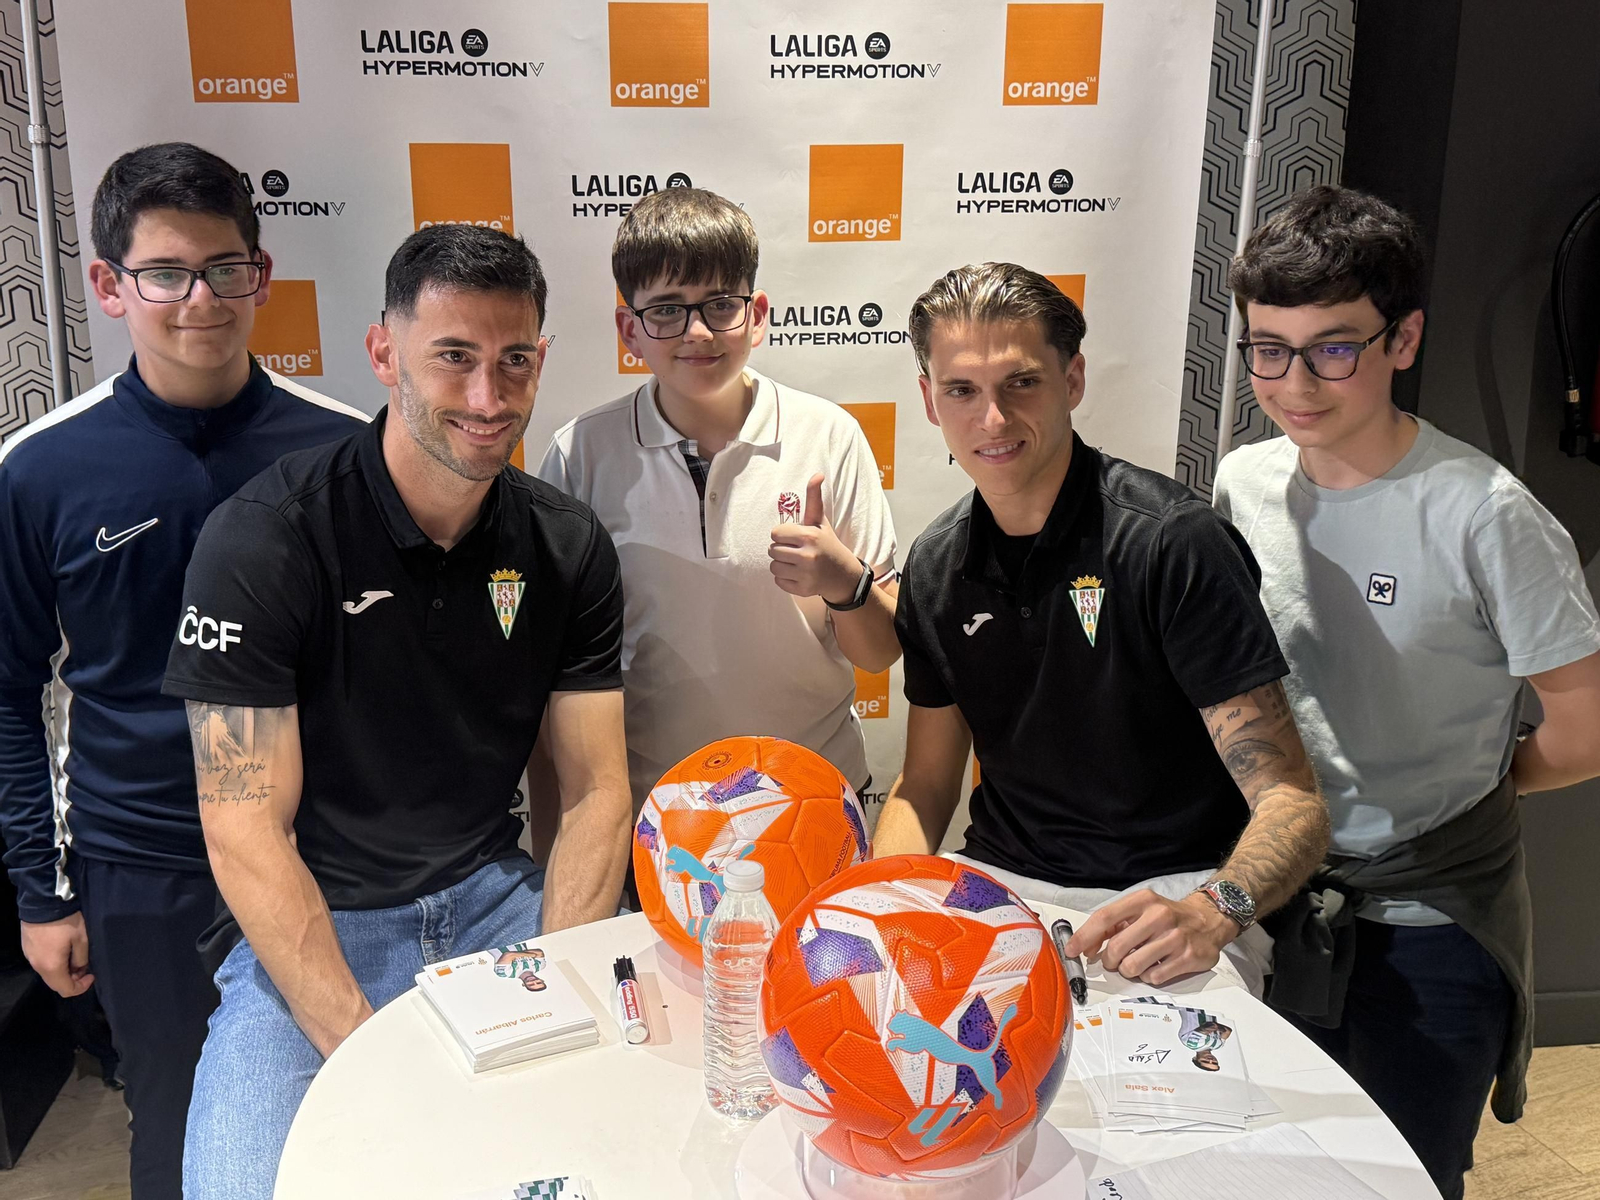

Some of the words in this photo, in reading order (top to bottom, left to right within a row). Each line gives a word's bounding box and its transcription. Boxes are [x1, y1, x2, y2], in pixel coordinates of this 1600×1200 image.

[360, 30, 454, 54] LALIGA
[770, 35, 858, 57] LALIGA
[198, 78, 288, 100] orange
[615, 83, 699, 104] orange
[1008, 82, 1089, 103] orange
[571, 175, 659, 197] LALIGA
[957, 172, 1042, 194] LALIGA
[813, 218, 892, 239] orange
[769, 305, 852, 327] LALIGA
[254, 353, 312, 374] ange
[519, 1011, 553, 1023] Carlos
[475, 1020, 518, 1036] Albarrán
[1124, 1083, 1149, 1092] Sala
[1152, 1085, 1176, 1094] Alex
